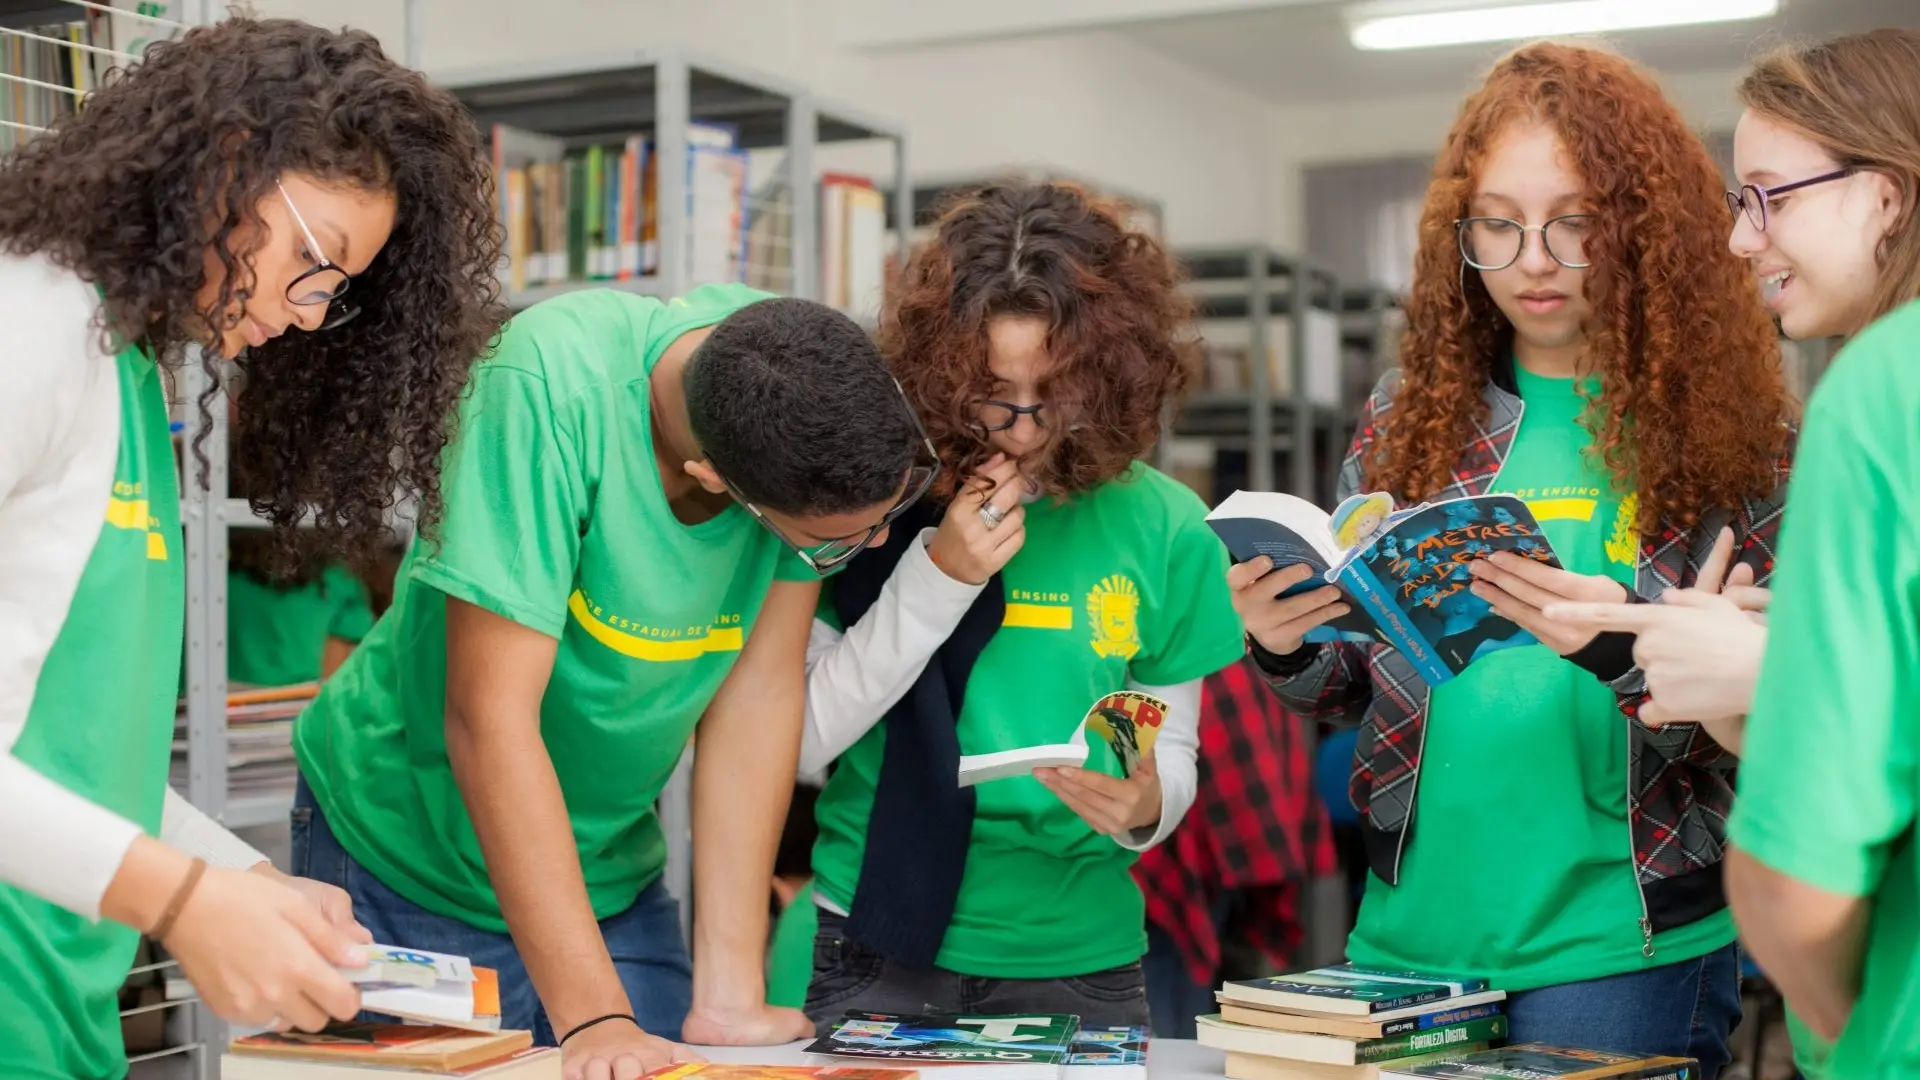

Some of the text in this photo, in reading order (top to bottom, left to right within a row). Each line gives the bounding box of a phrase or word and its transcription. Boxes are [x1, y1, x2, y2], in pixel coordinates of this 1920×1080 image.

[1517, 488, 1535, 499] DE
[1541, 486, 1600, 497] ENSINO
[1012, 589, 1070, 602] ENSINO
[1106, 692, 1167, 712] WSKI
[1410, 1031, 1446, 1050] FORTALEZA
[1445, 1027, 1469, 1044] DIGITAL
